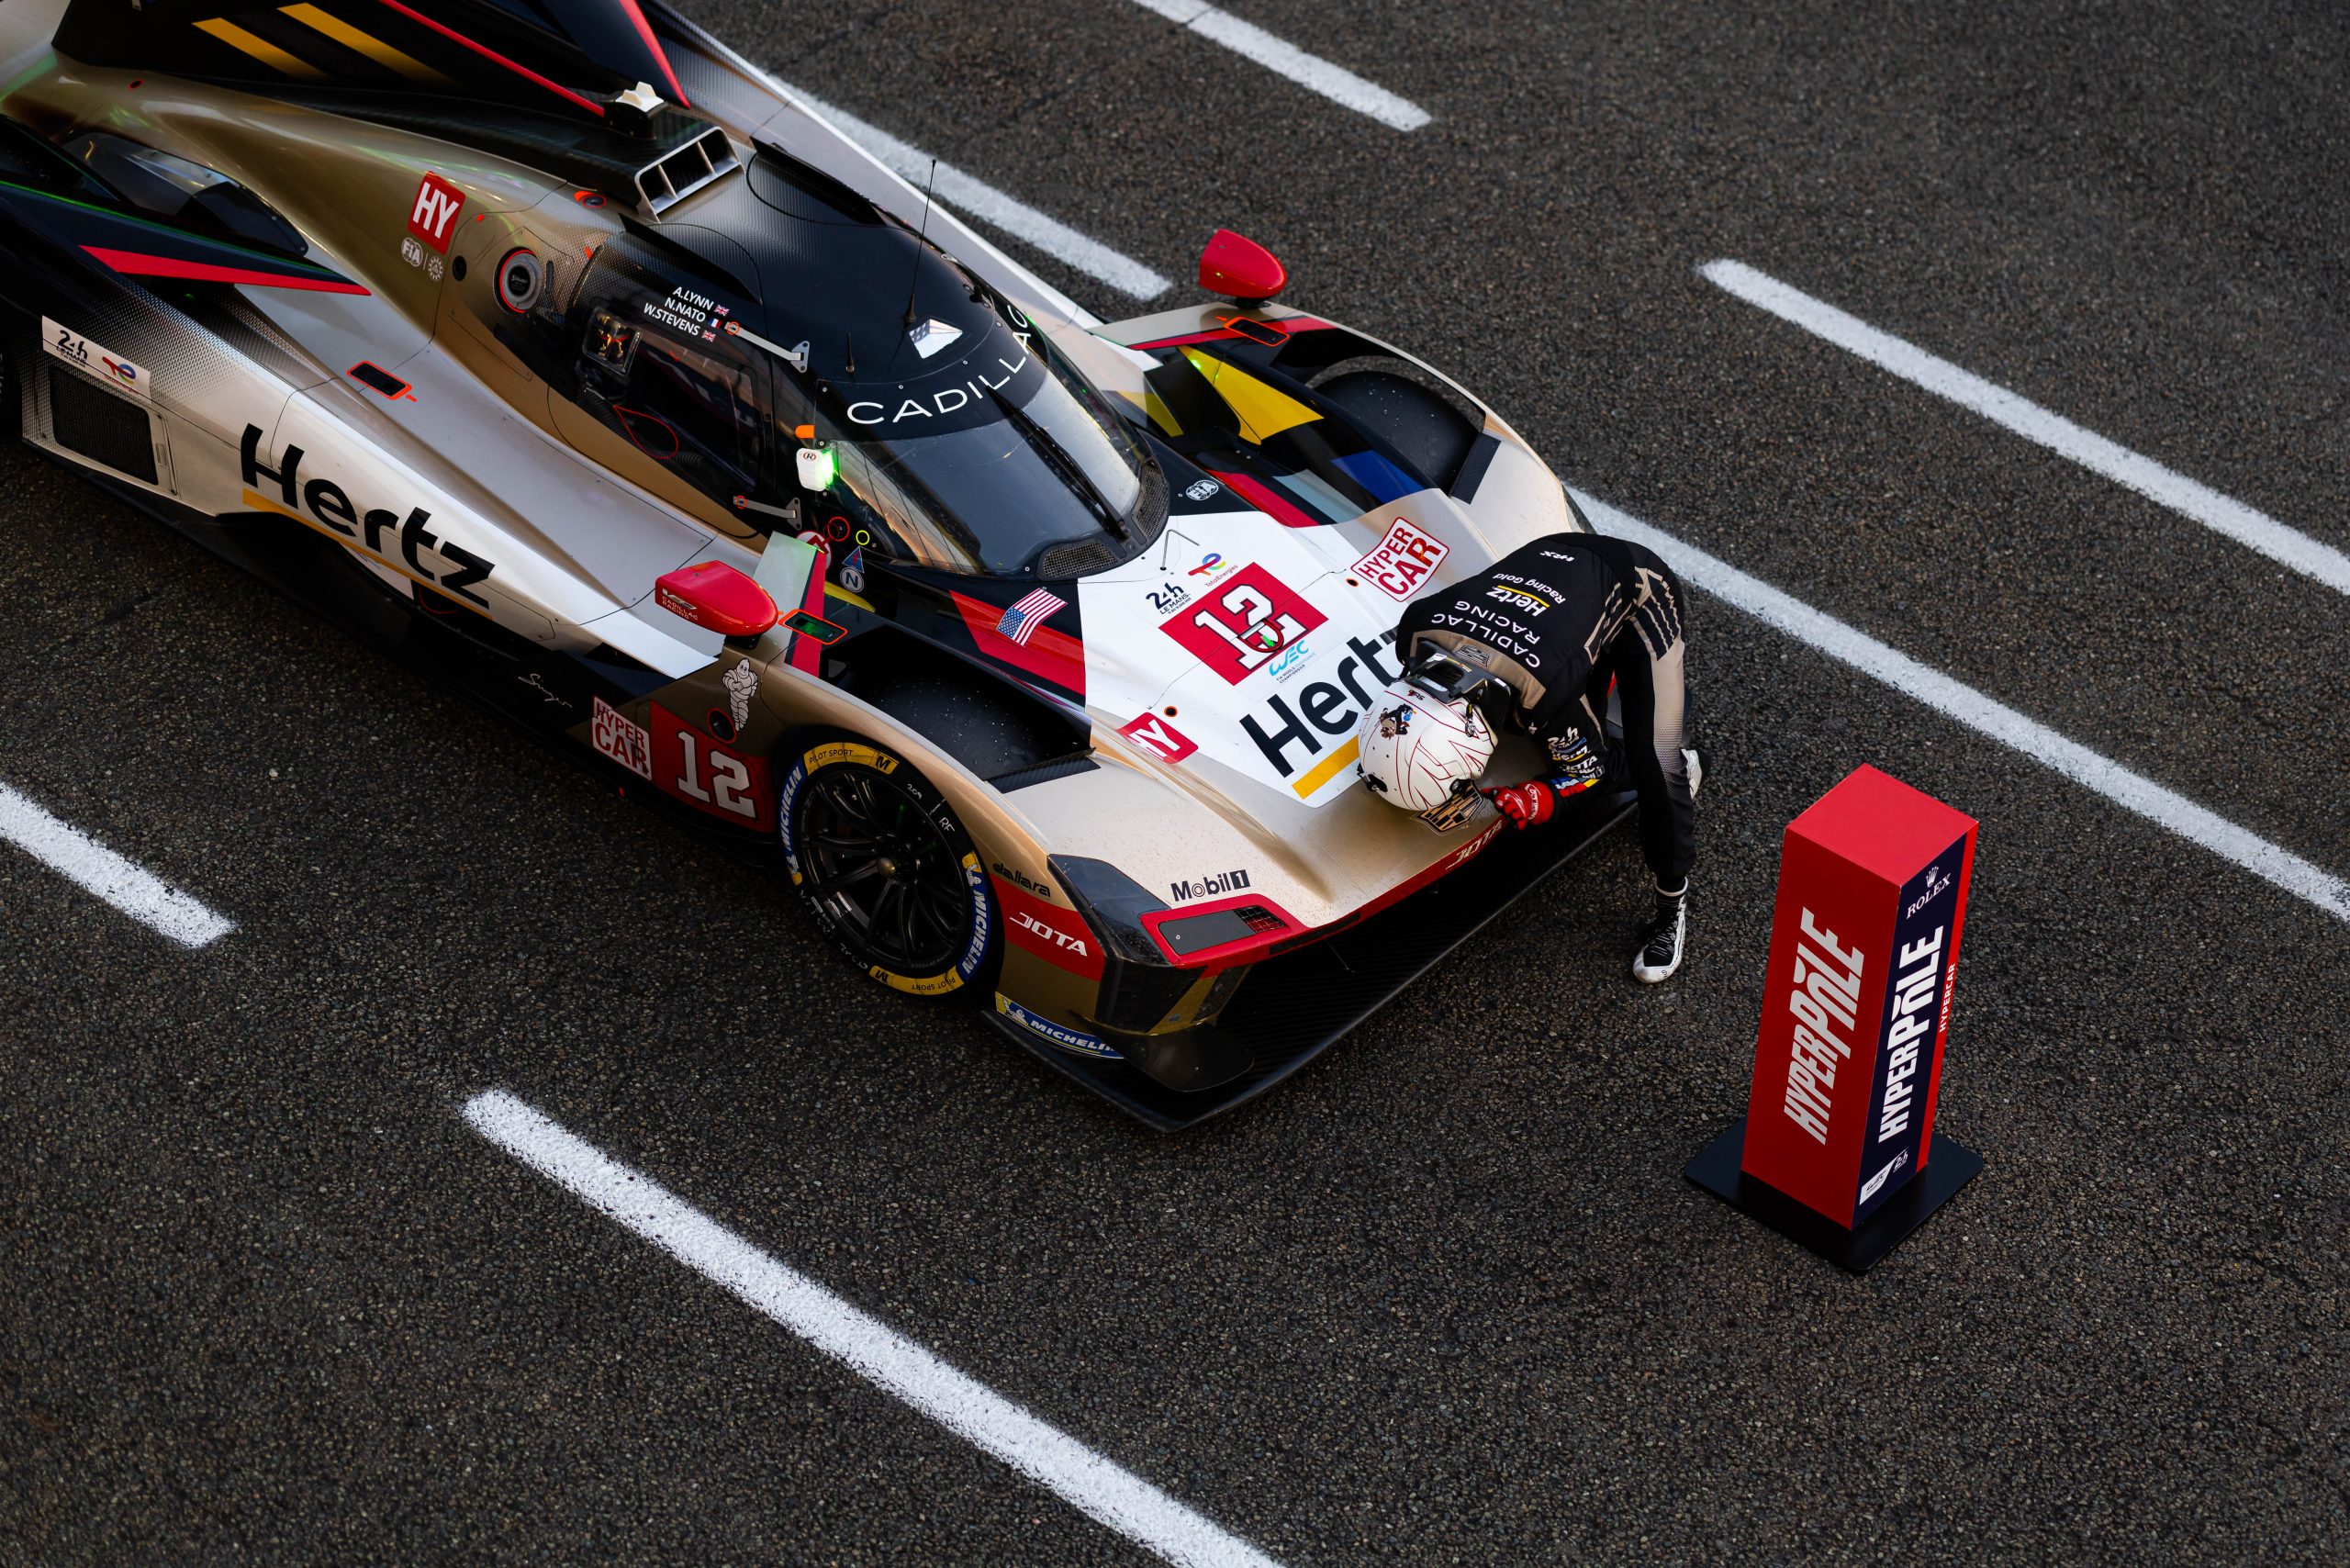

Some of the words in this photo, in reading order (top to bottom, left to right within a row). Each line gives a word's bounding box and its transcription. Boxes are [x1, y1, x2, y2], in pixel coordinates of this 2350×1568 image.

[413, 181, 460, 240] HY
[664, 297, 706, 322] N.NATO
[672, 286, 714, 311] A.LYNN
[643, 302, 701, 336] W.STEVENS
[846, 305, 1032, 425] CADILLAC
[241, 422, 496, 610] Hertz
[1358, 527, 1414, 579] HYPER
[1378, 537, 1442, 595] CAR
[1204, 564, 1239, 588] TotalEnergies
[1493, 573, 1524, 584] Gold
[1525, 578, 1566, 604] Racing
[662, 596, 699, 621] CADILLAC
[662, 601, 690, 620] RACING
[1146, 582, 1184, 610] 24h
[1159, 605, 1170, 615] LE
[1485, 586, 1547, 617] Hertz
[1193, 584, 1310, 672] 12
[1430, 612, 1541, 668] CADILLAC
[1454, 600, 1541, 644] RACING
[1269, 640, 1309, 677] WEC
[597, 701, 645, 749] HYPER
[1128, 719, 1181, 758] HY
[595, 722, 650, 775] CAR
[809, 751, 826, 764] PILOT
[828, 749, 854, 757] SPORT
[875, 756, 890, 770] M
[677, 731, 757, 819] 12
[780, 766, 802, 852] MICHELIN
[993, 862, 1051, 898] dallara
[1906, 872, 1952, 919] ROLEX
[962, 889, 987, 975] MICHELIN
[1009, 912, 1088, 958] JOTA
[874, 969, 890, 983] M
[912, 983, 936, 991] SPORT
[937, 976, 956, 990] PILOT
[1938, 962, 1956, 1034] HYPERCAR
